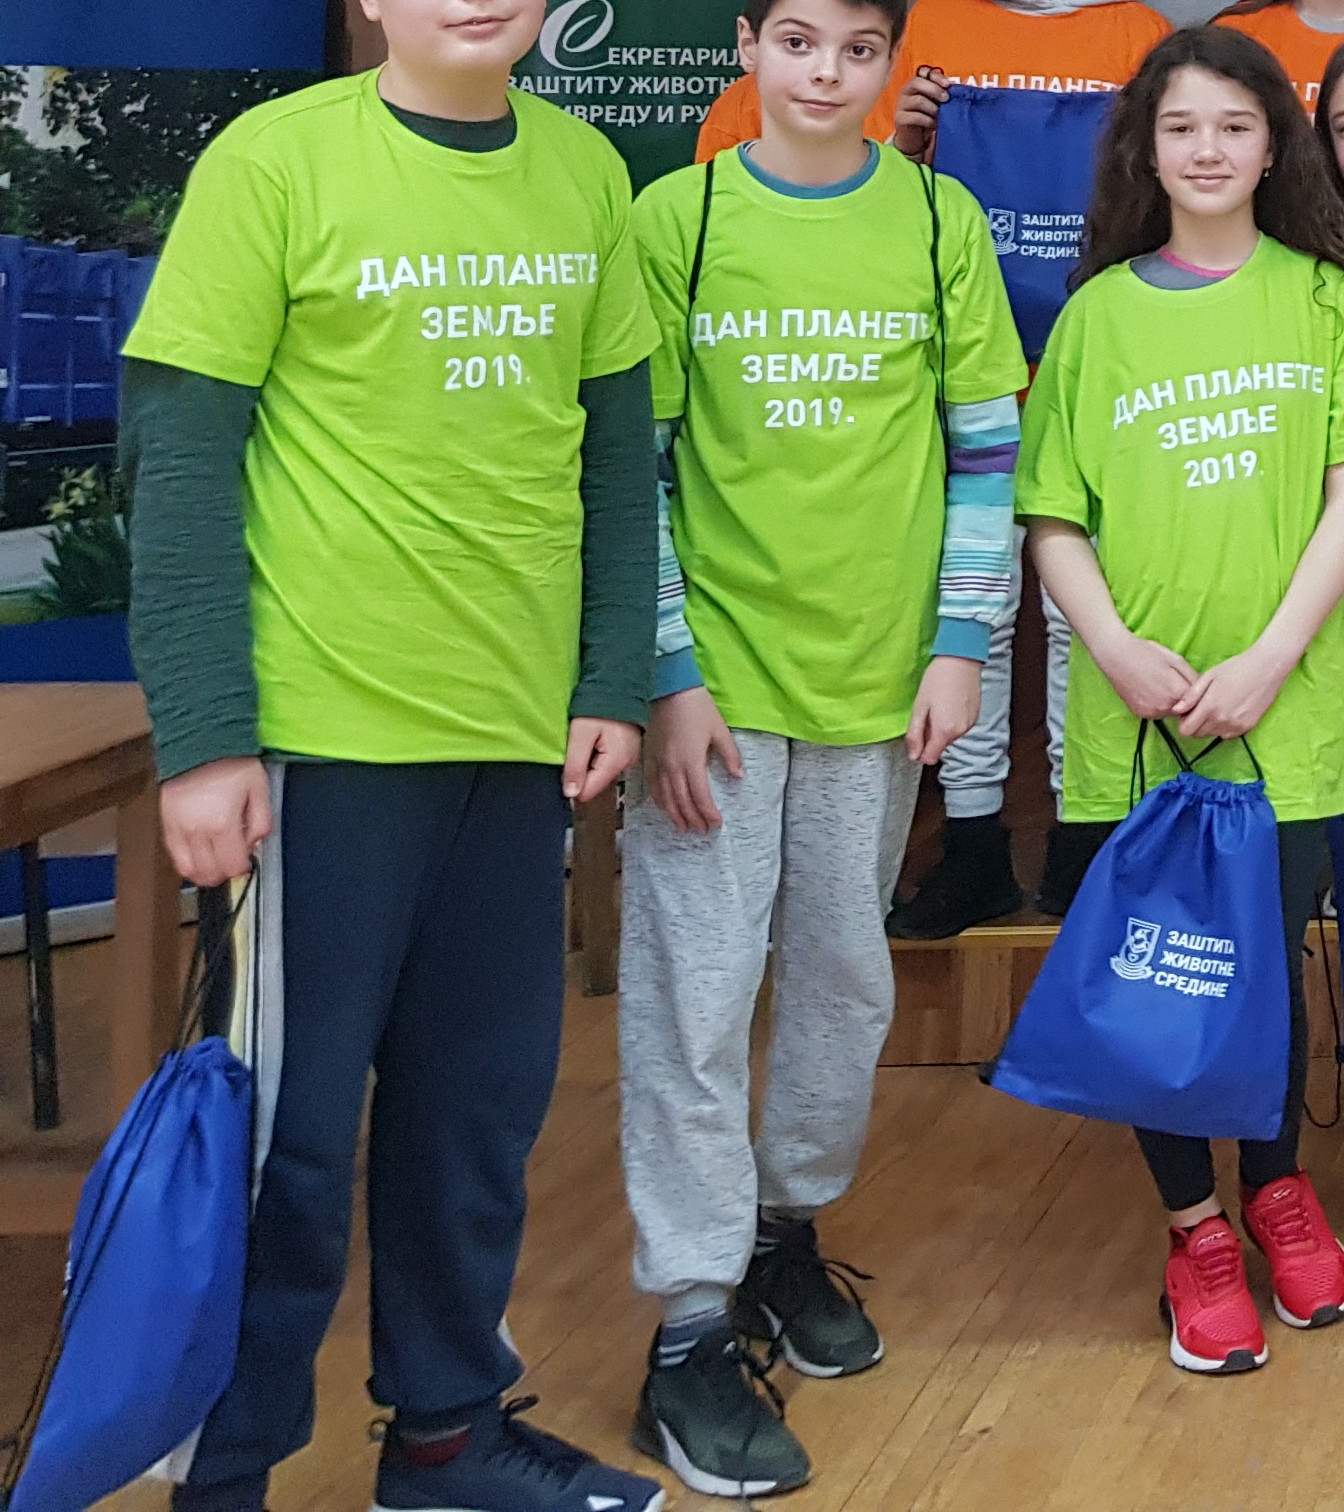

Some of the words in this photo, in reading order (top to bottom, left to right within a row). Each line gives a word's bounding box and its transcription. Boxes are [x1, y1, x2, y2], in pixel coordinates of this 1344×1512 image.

[629, 76, 742, 95] ЖИВОТН
[657, 105, 674, 123] И
[1021, 214, 1085, 226] ЗАШТИТА
[356, 254, 446, 300] ДАН
[457, 253, 598, 287] ПЛАНЕТЕ
[421, 304, 556, 339] ЗЕМЉЕ
[693, 309, 768, 347] ДАН
[444, 354, 531, 391] 2019.
[741, 353, 882, 383] ЗЕМЉЕ
[1113, 378, 1178, 430] ДАН
[1184, 362, 1325, 402] ПЛАНЕТЕ
[765, 397, 854, 428] 2019.
[1157, 404, 1278, 450] ЗЕМЉЕ
[1183, 449, 1265, 488] 2019.
[1166, 931, 1235, 954] ЗАШТИТА
[1159, 951, 1236, 977] ЖИВОТНЕ
[1154, 972, 1229, 998] СРЕДИНЕ
